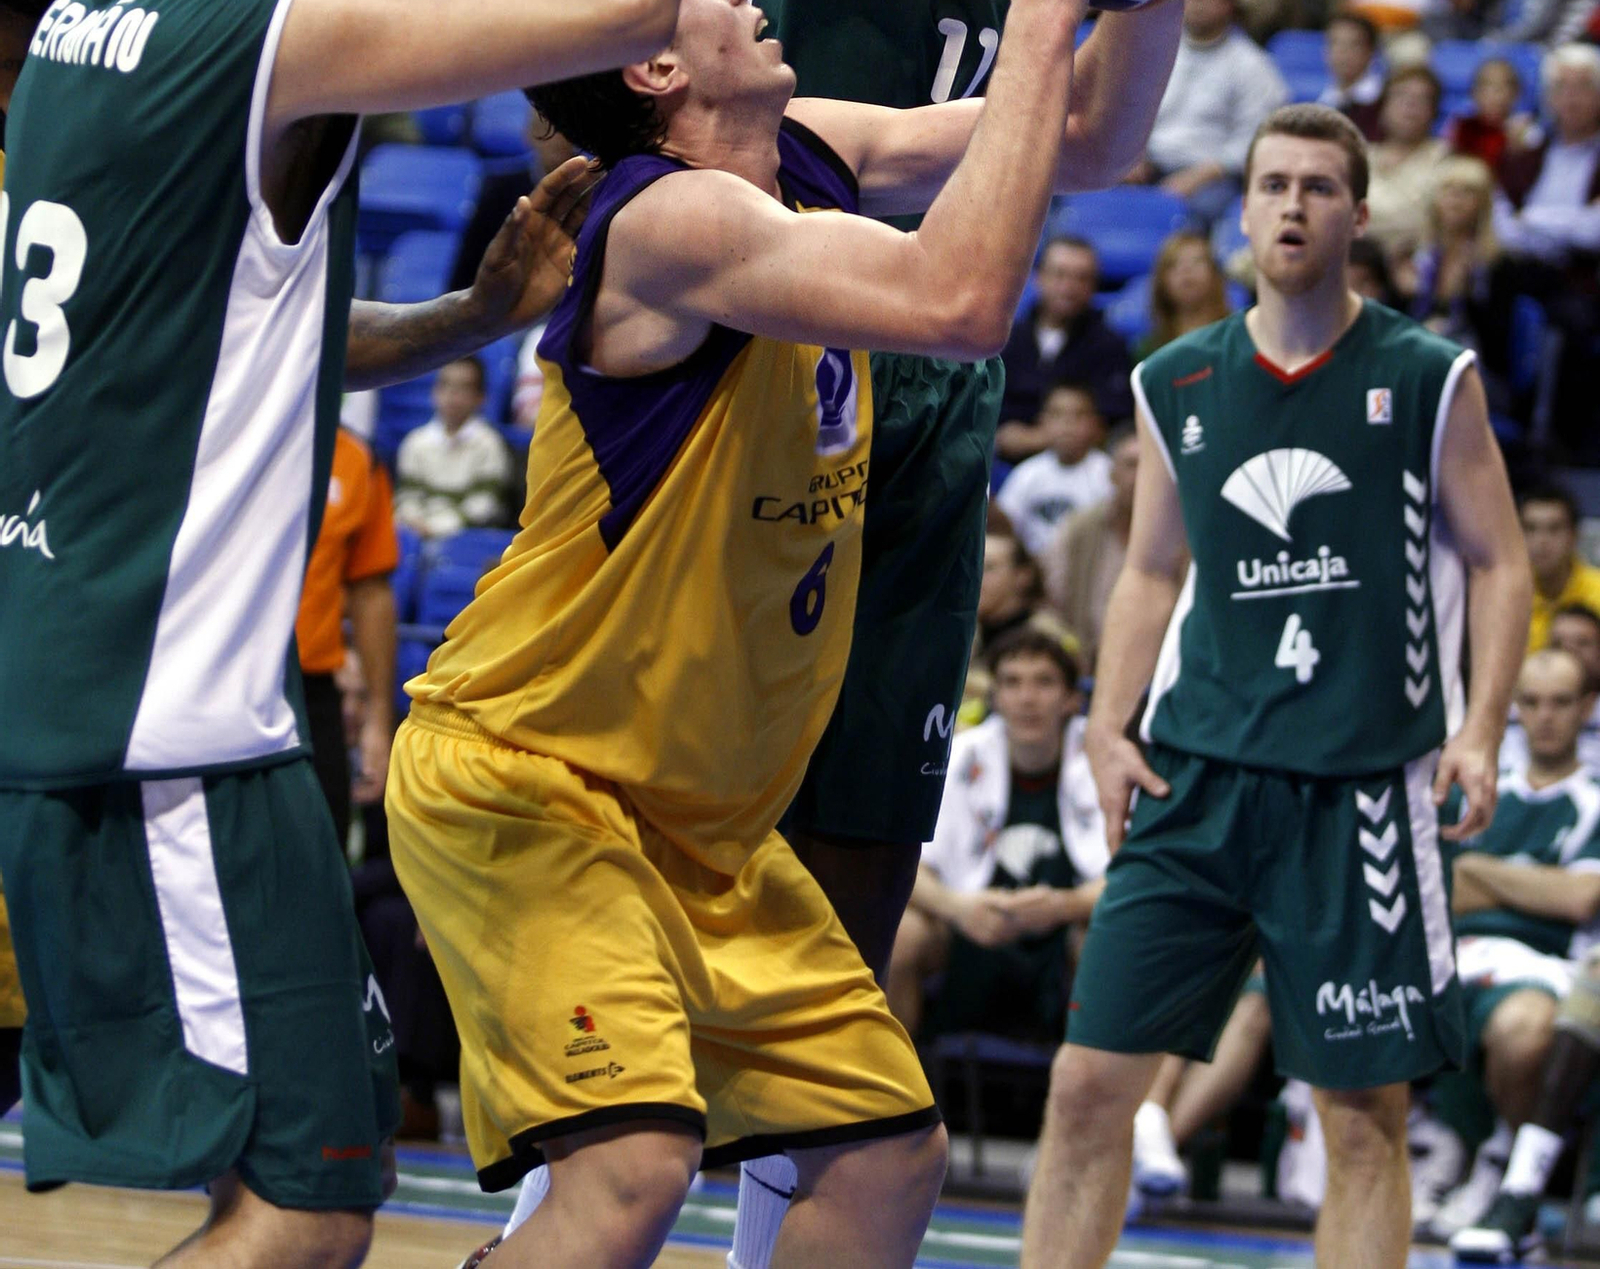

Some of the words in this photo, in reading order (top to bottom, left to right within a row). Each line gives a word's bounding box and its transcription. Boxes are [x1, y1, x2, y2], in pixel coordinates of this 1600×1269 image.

[931, 18, 998, 103] 11
[790, 541, 834, 636] 6
[1237, 545, 1350, 587] Unicaja
[1274, 613, 1320, 684] 4
[1316, 978, 1425, 1042] Málaga
